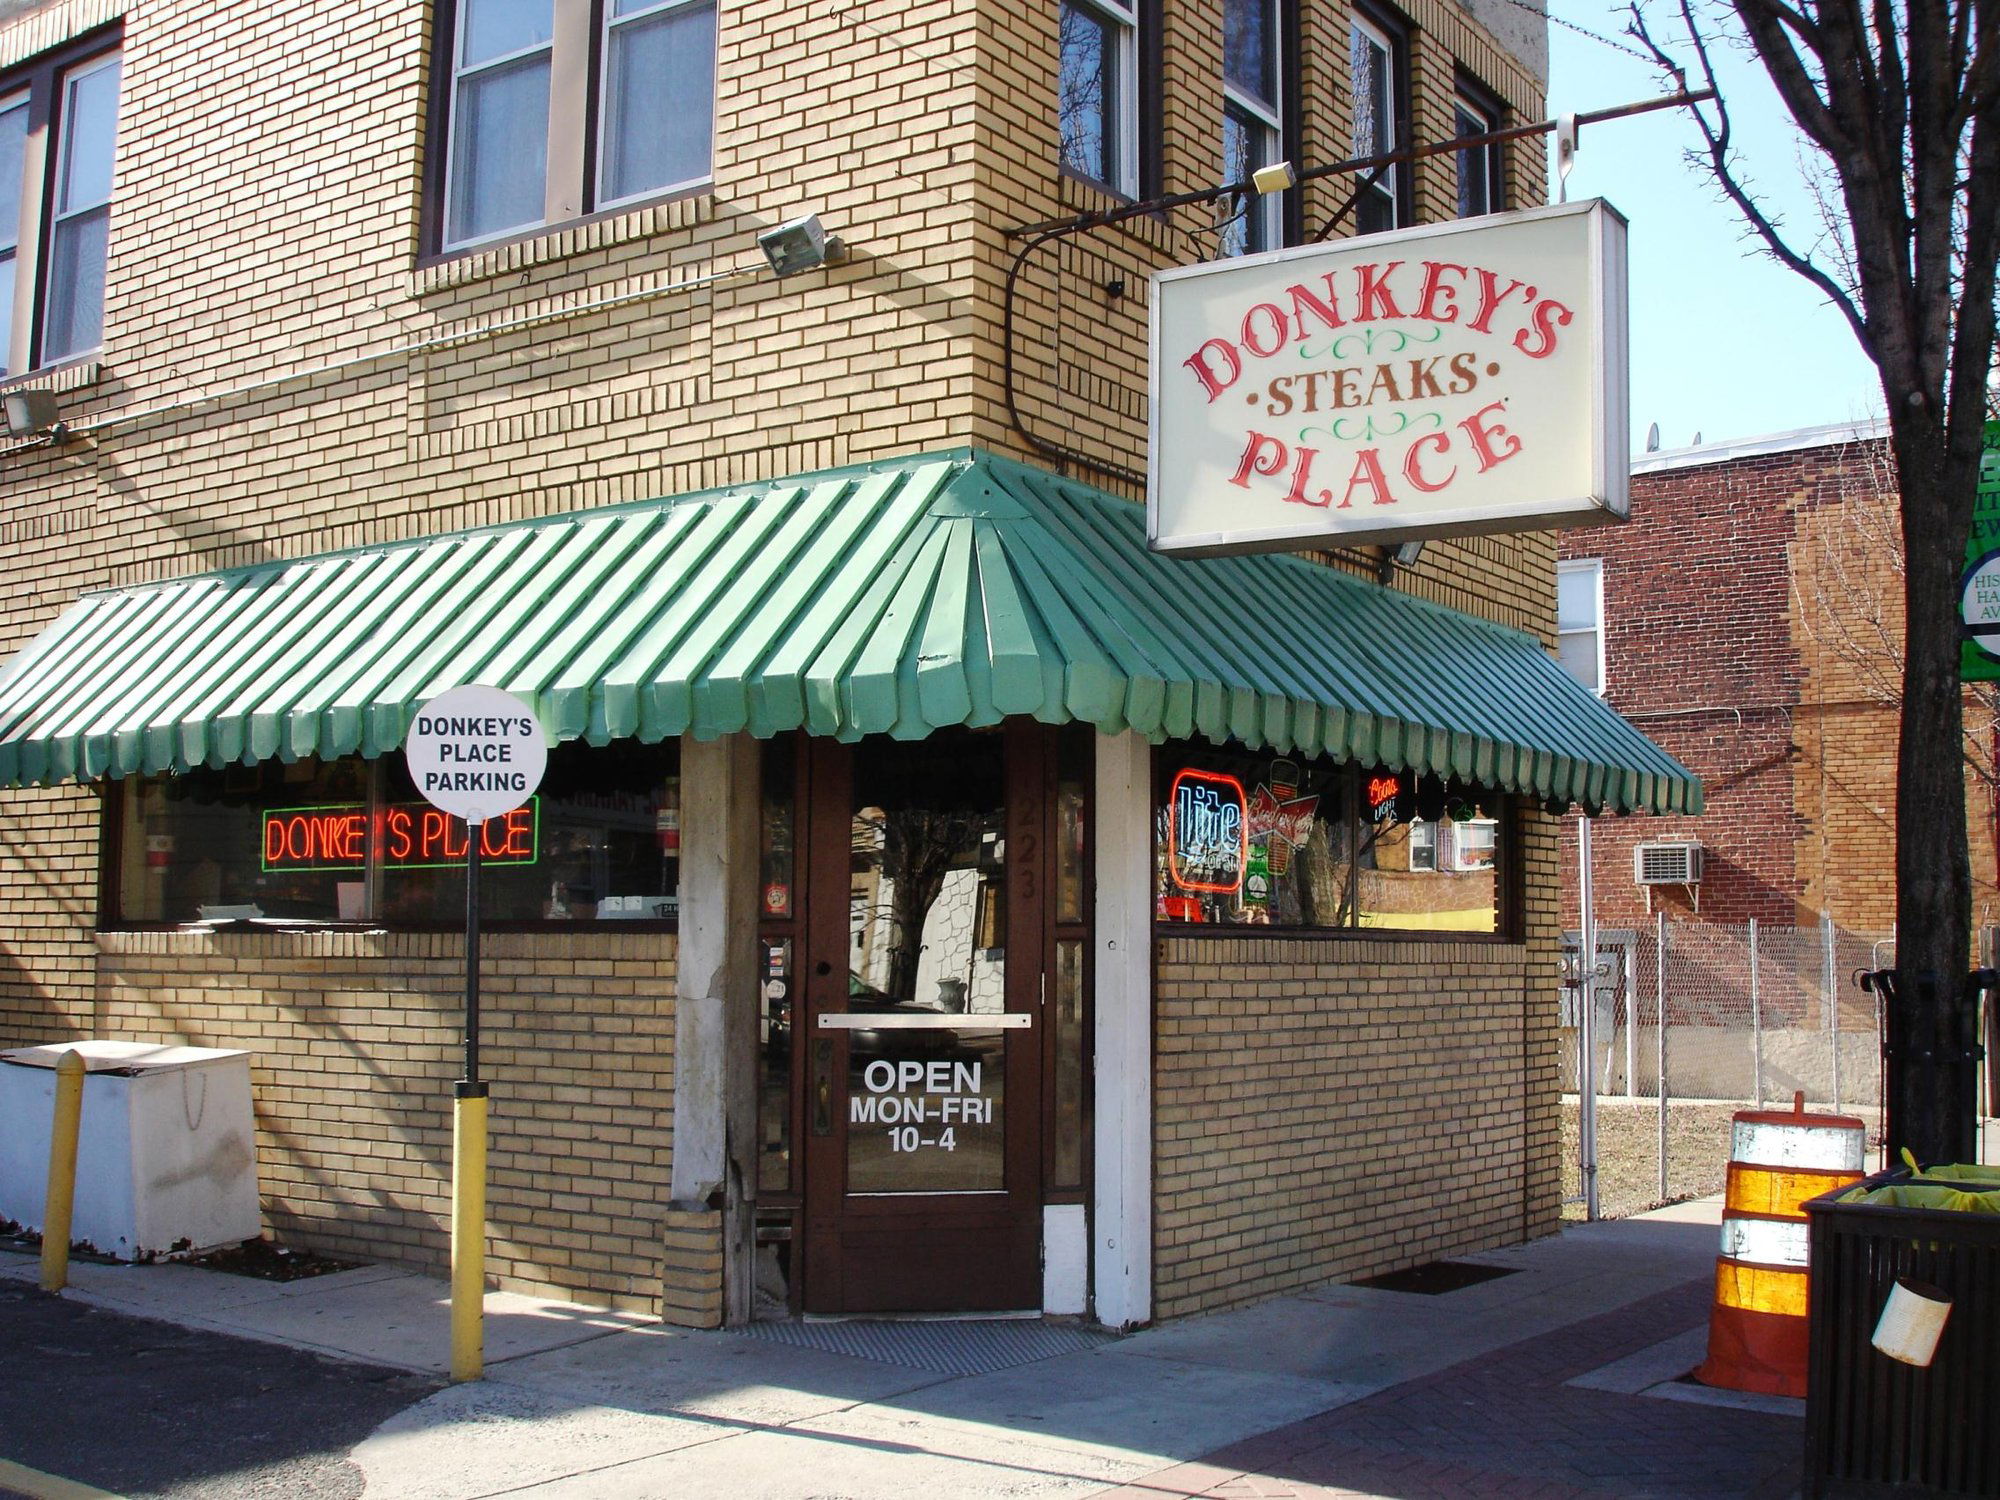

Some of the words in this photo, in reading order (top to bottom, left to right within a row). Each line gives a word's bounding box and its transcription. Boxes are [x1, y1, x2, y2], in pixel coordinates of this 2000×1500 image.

[1183, 260, 1574, 403] DONKEY'S
[1267, 352, 1478, 417] STEAKS
[1228, 400, 1522, 508] PLACE
[418, 717, 532, 736] DONKEY'S
[440, 744, 512, 762] PLACE
[425, 772, 526, 791] PARKING
[266, 808, 412, 860] DONKE'S
[864, 1061, 981, 1093] OPEN
[851, 1097, 992, 1124] MON-FRI
[888, 1127, 956, 1152] 10-4
